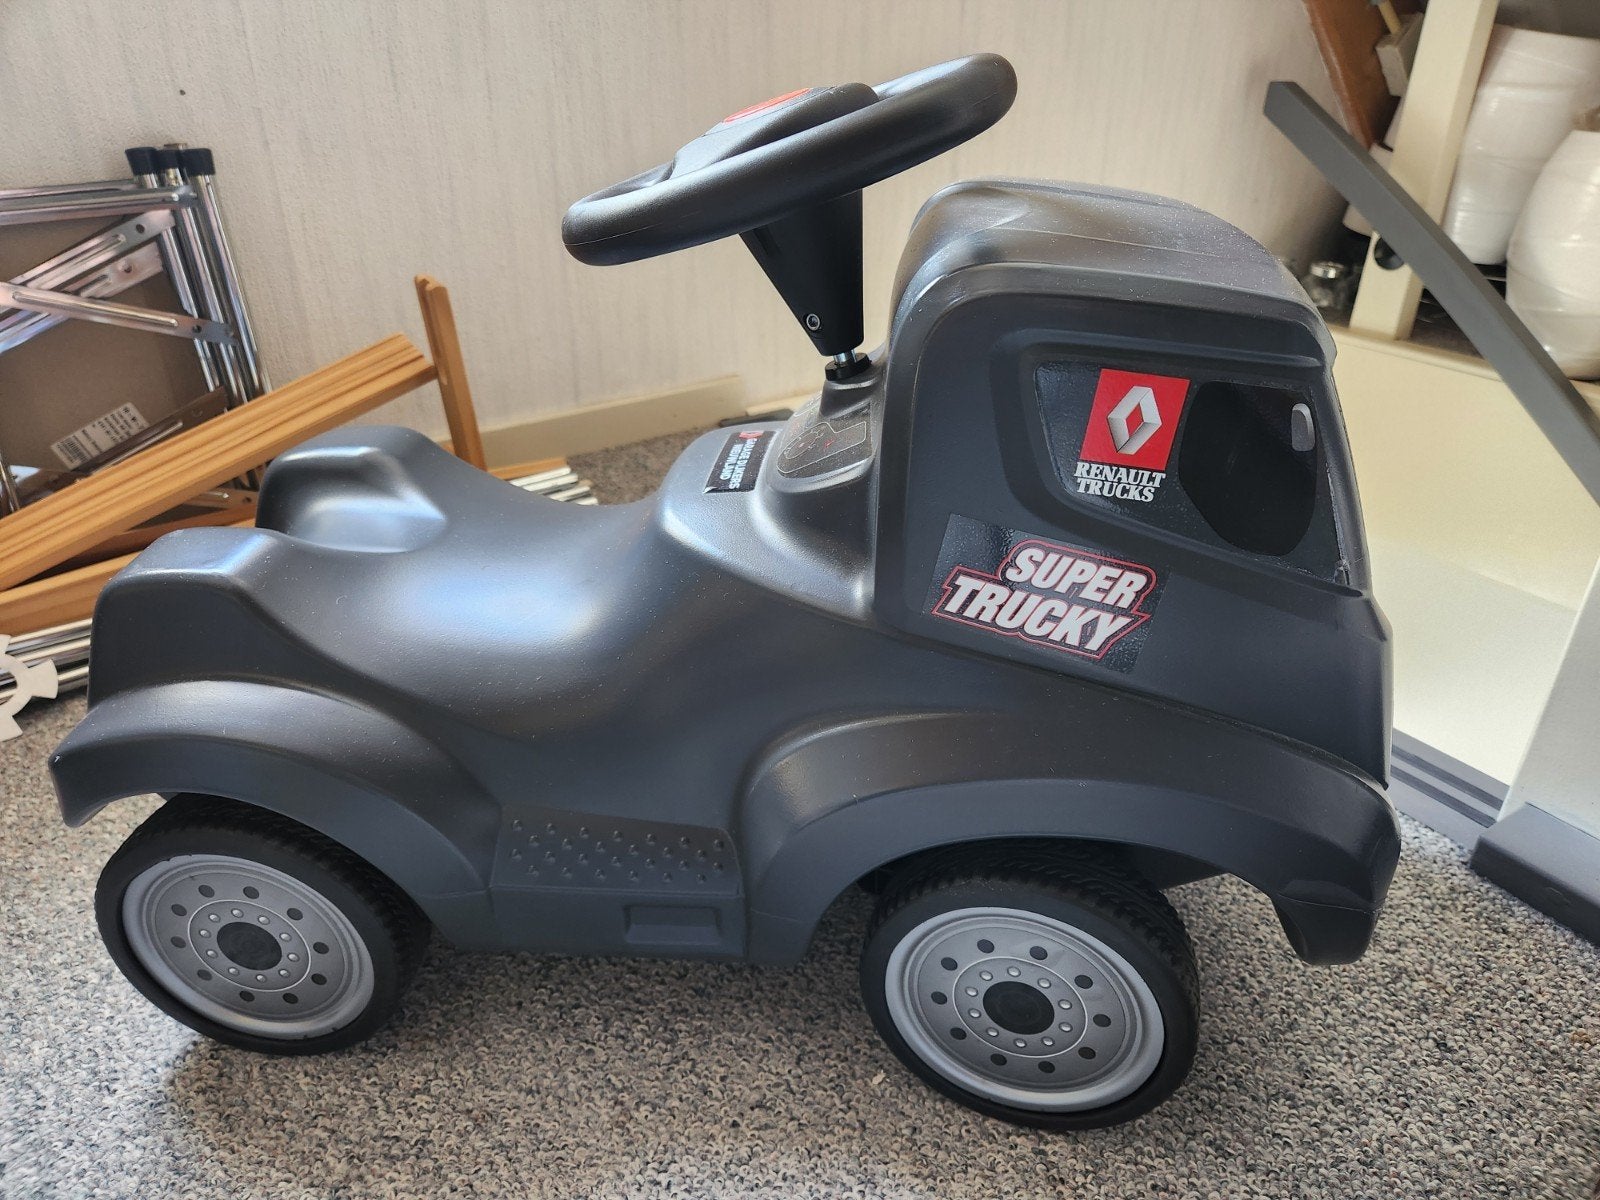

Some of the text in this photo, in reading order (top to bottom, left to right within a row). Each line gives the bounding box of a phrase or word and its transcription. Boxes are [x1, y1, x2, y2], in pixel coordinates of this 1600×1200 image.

[1074, 462, 1166, 488] RENAULT
[1077, 478, 1155, 502] TRUCKS
[1005, 547, 1147, 609] SUPER
[943, 575, 1134, 651] TRUCKY
